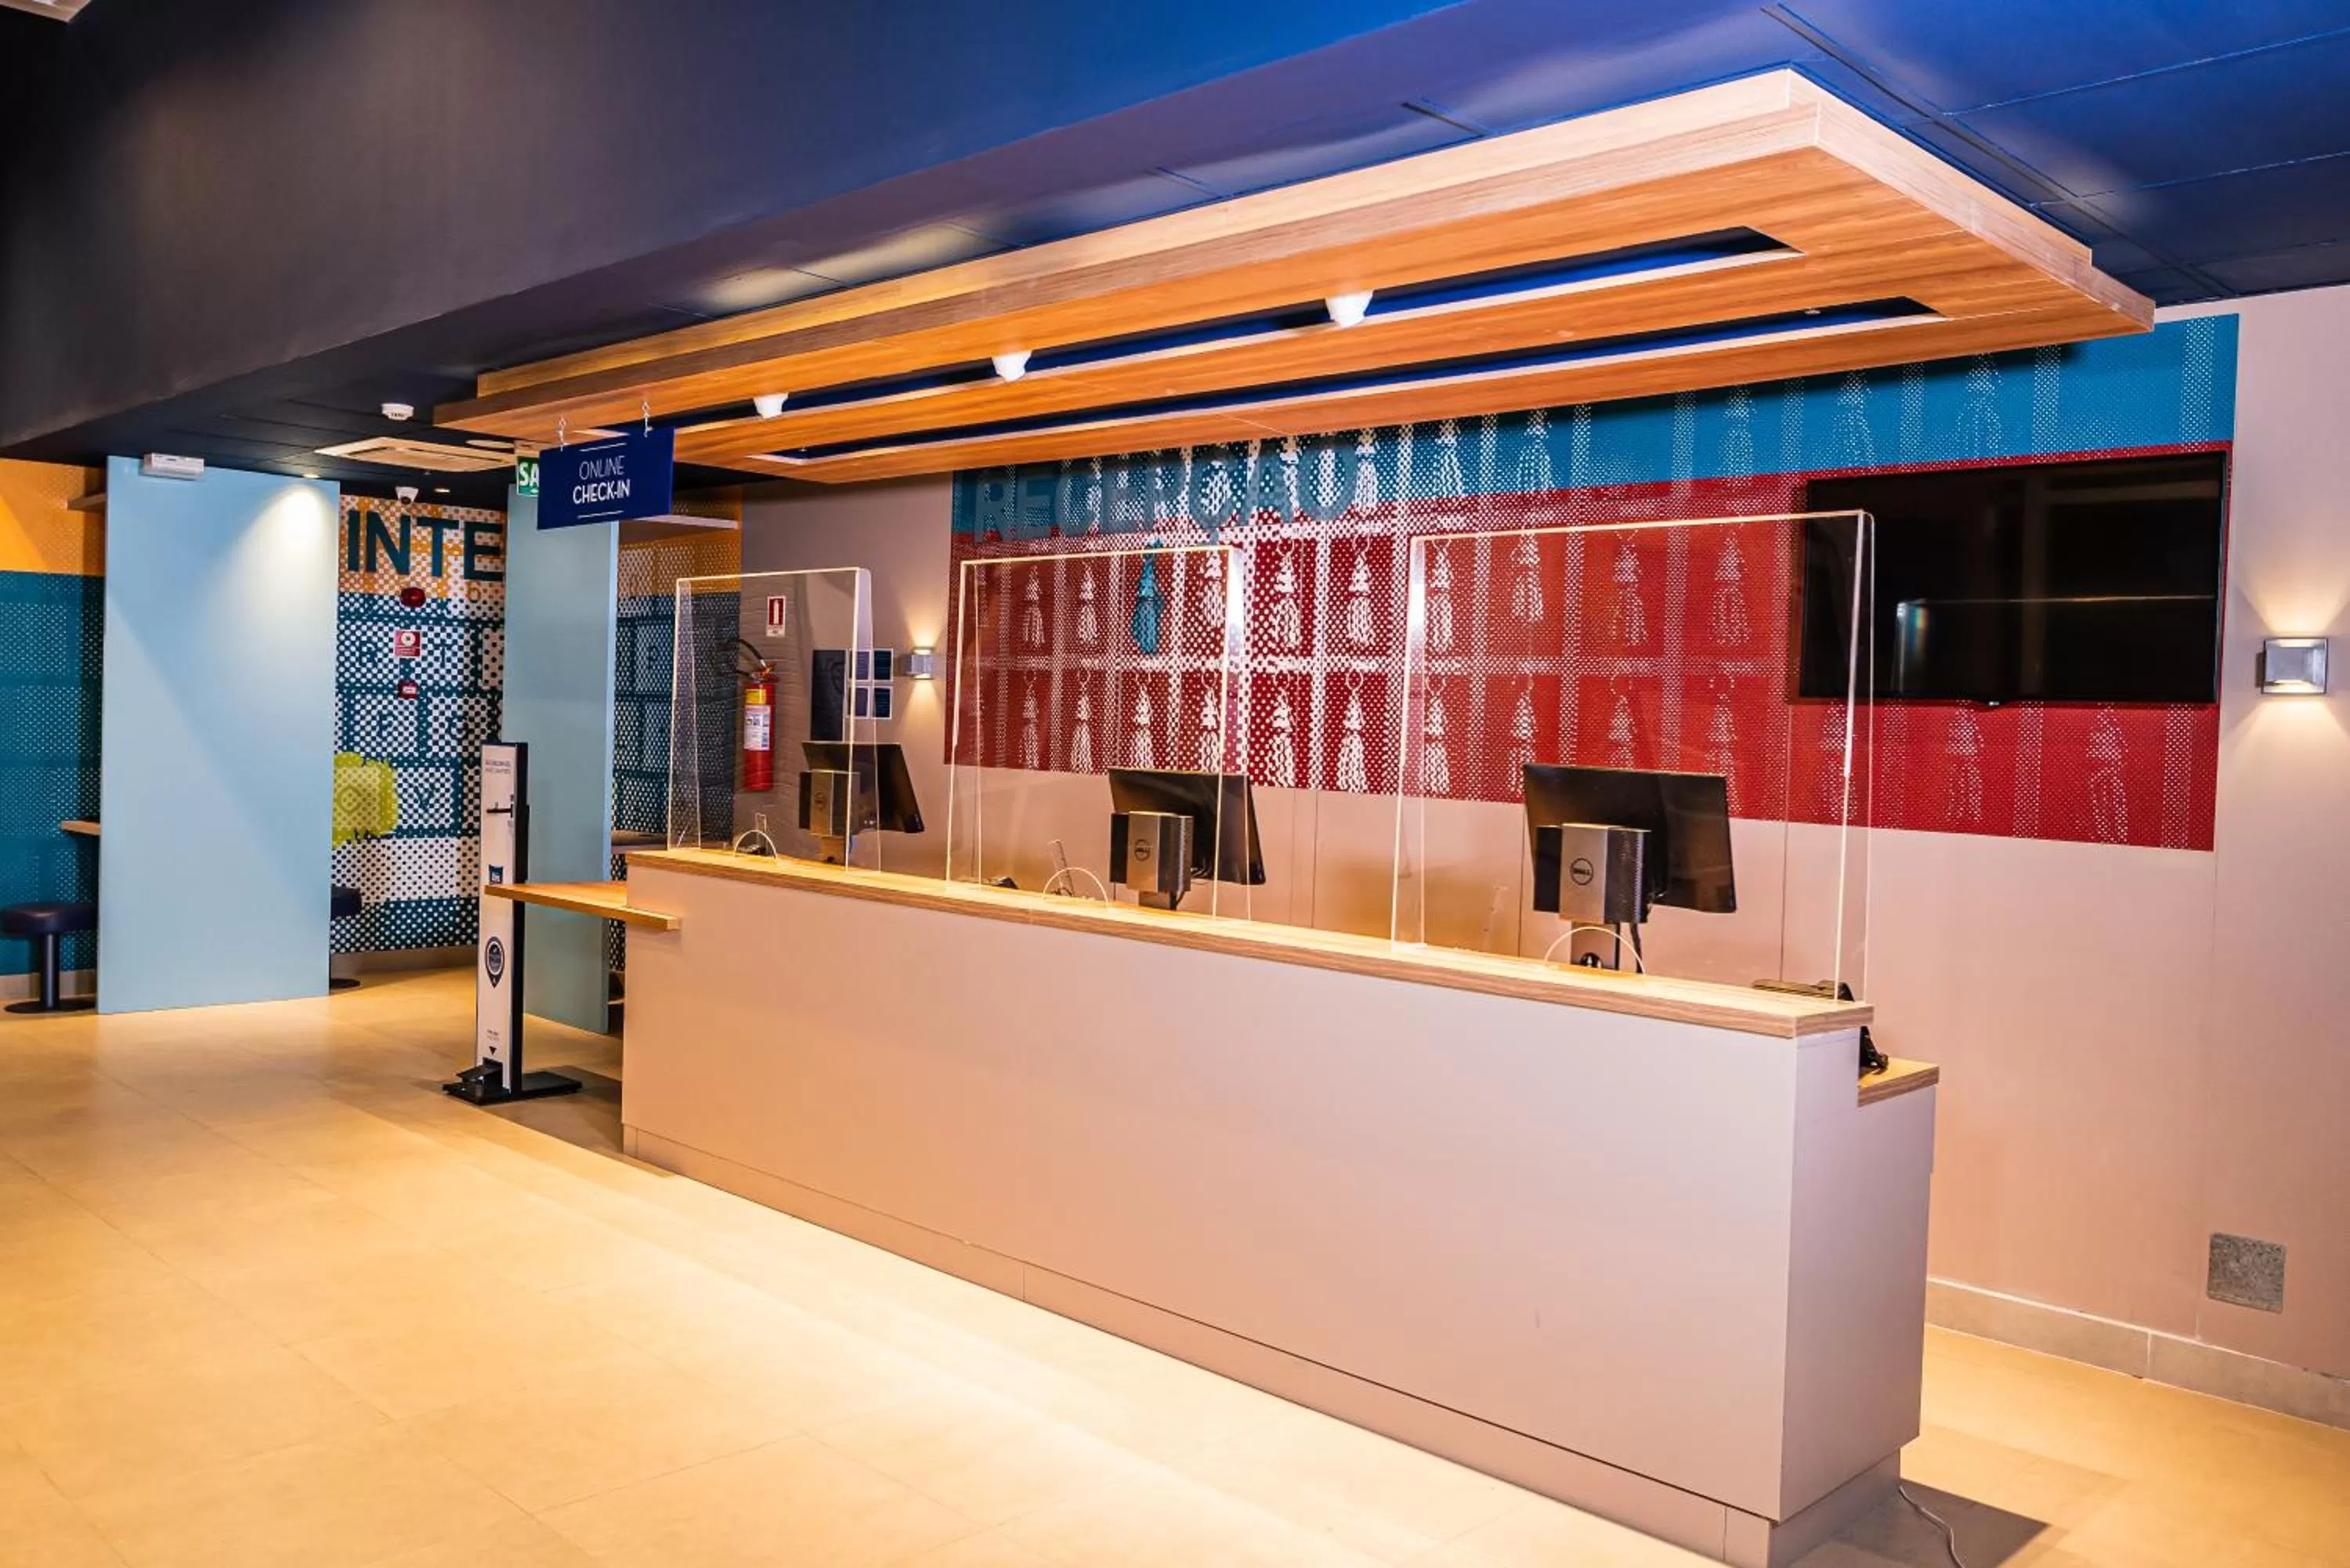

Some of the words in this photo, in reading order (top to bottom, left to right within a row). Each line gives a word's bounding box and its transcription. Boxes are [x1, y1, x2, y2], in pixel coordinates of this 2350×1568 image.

[519, 462, 539, 486] SA
[579, 456, 626, 480] ONLINE
[573, 479, 631, 504] CHECK-IN
[348, 509, 504, 581] INTE
